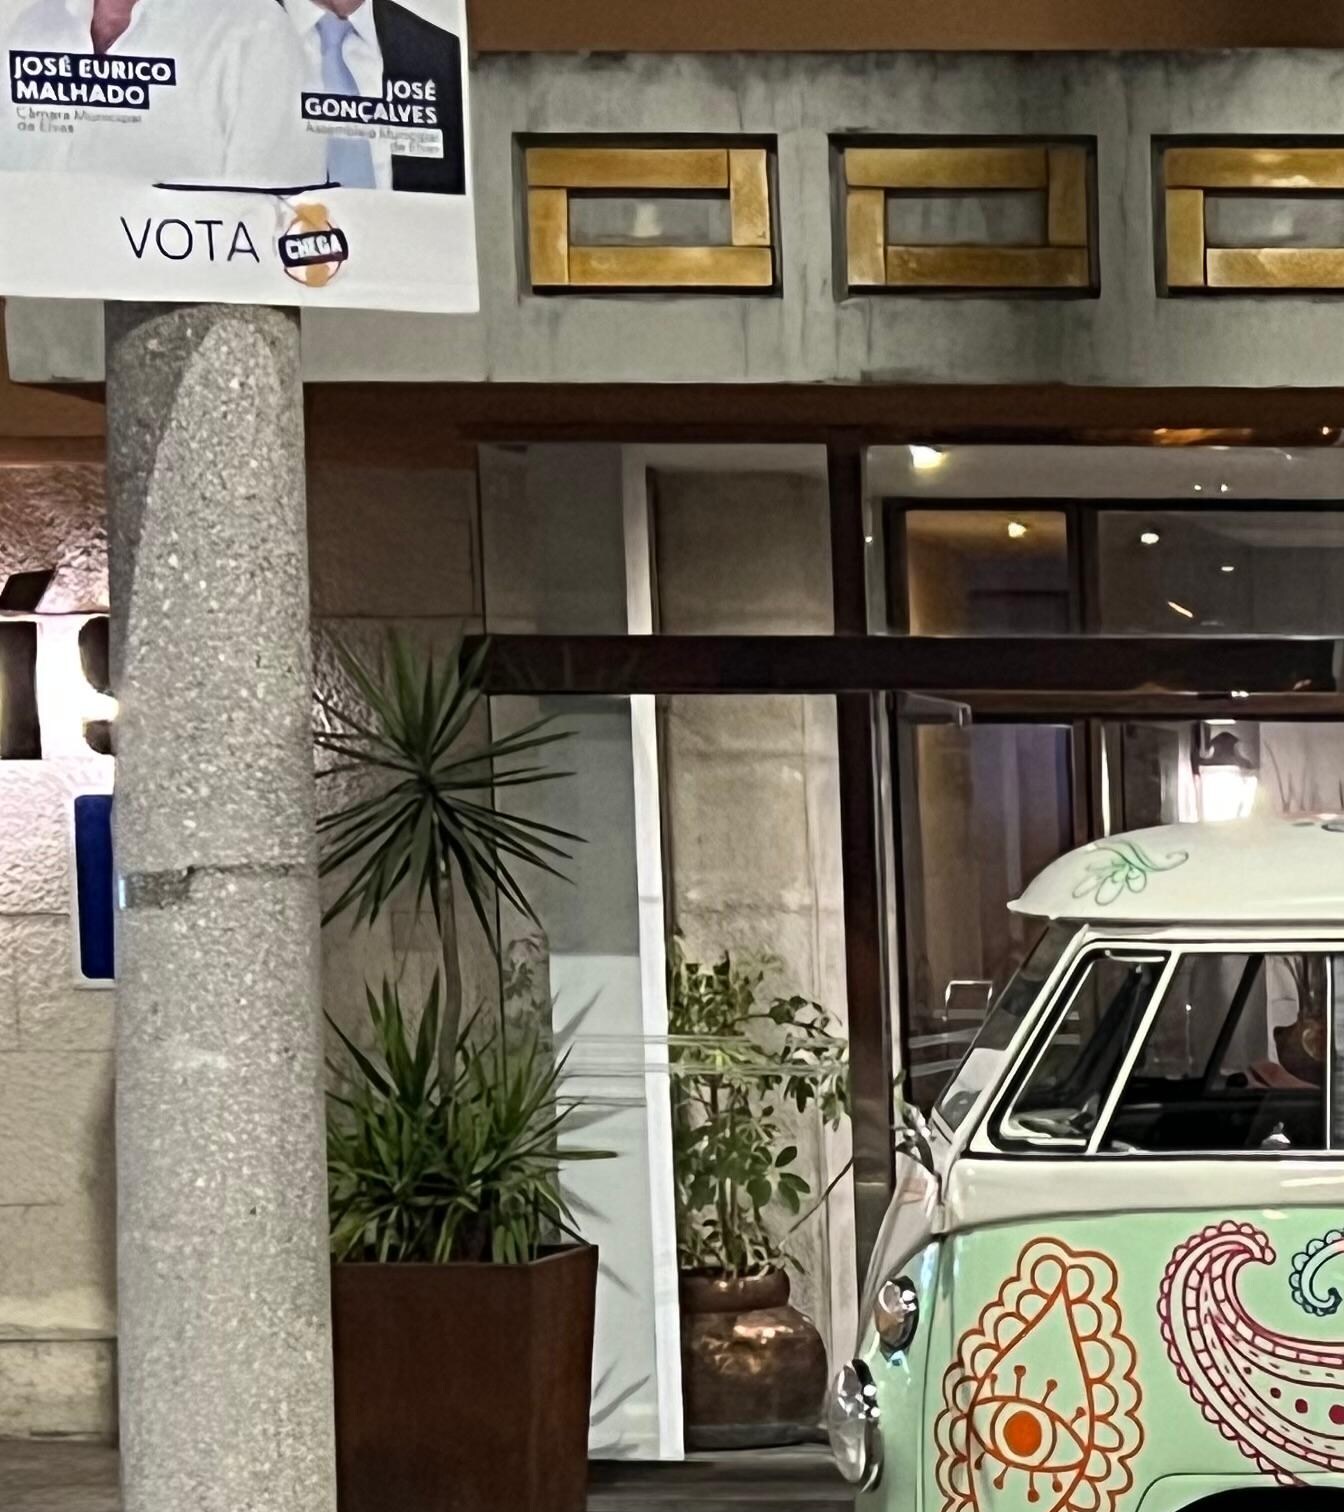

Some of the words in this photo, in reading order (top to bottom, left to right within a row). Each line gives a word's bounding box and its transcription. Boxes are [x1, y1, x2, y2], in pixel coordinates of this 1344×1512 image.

[14, 54, 73, 79] JOSÉ
[79, 59, 172, 82] EURICO
[16, 80, 145, 105] MALHADO
[386, 78, 437, 102] JOSÉ
[304, 97, 438, 124] GONÇALVES
[119, 216, 260, 263] VOTA
